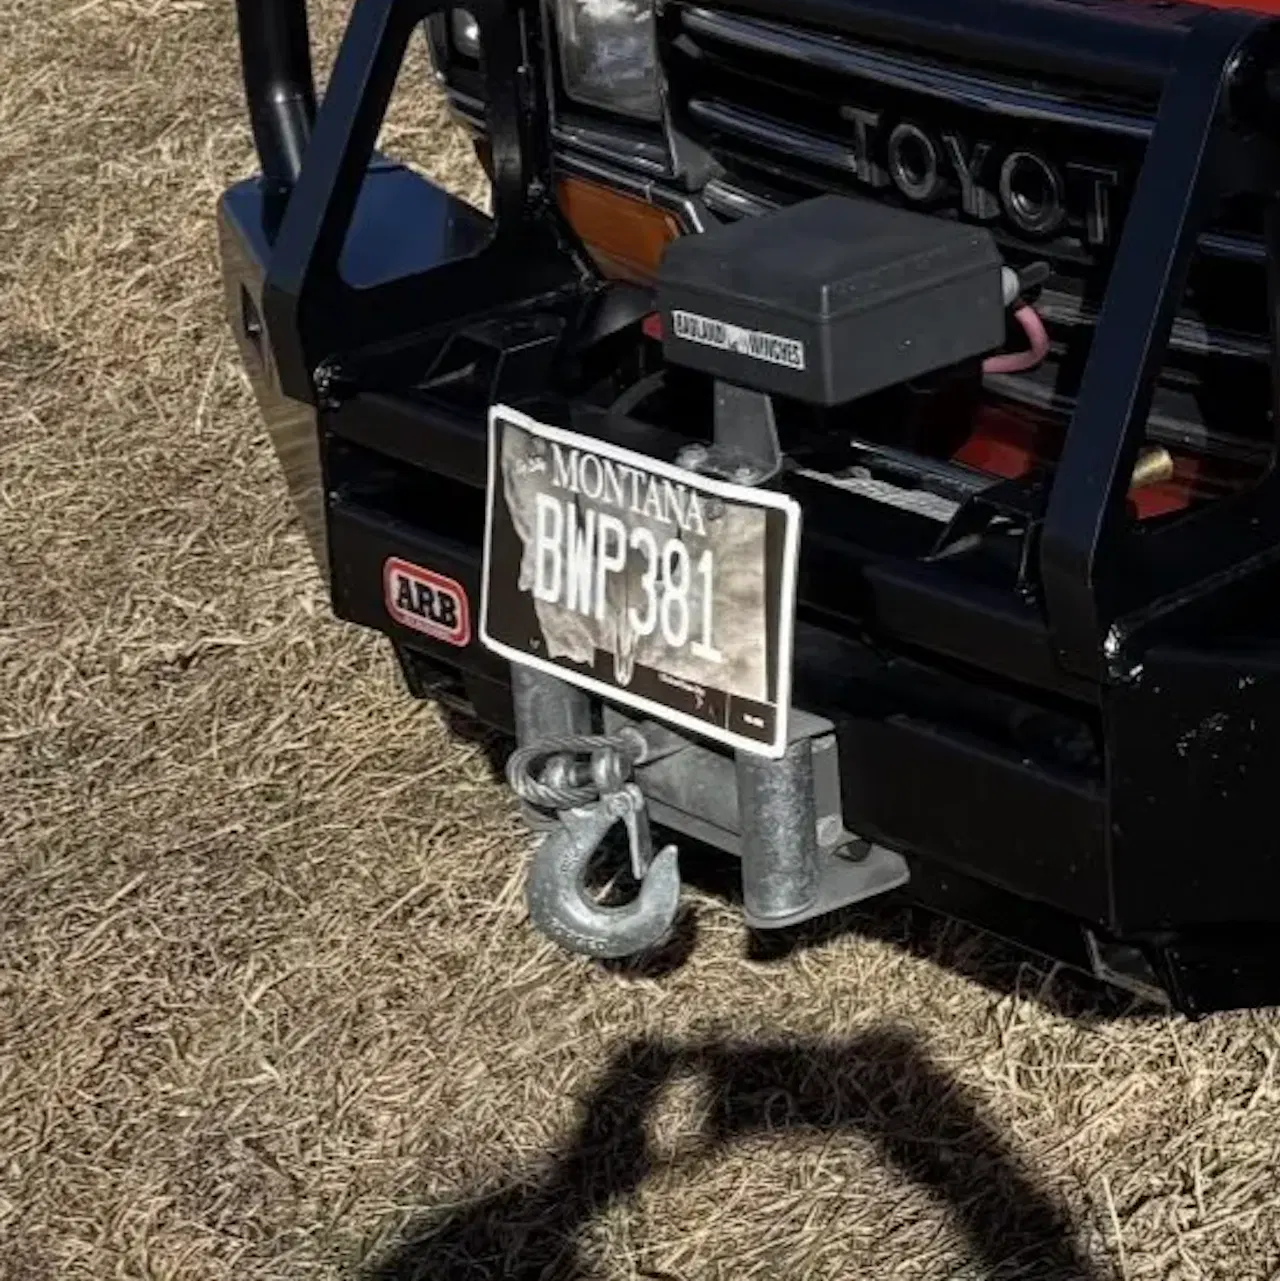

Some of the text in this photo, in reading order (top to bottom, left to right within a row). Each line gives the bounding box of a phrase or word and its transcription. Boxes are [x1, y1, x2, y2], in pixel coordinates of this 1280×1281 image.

[838, 104, 1120, 246] TOYOT
[551, 442, 707, 536] MONTANA
[397, 574, 458, 629] ARB
[532, 493, 726, 664] BWP381
